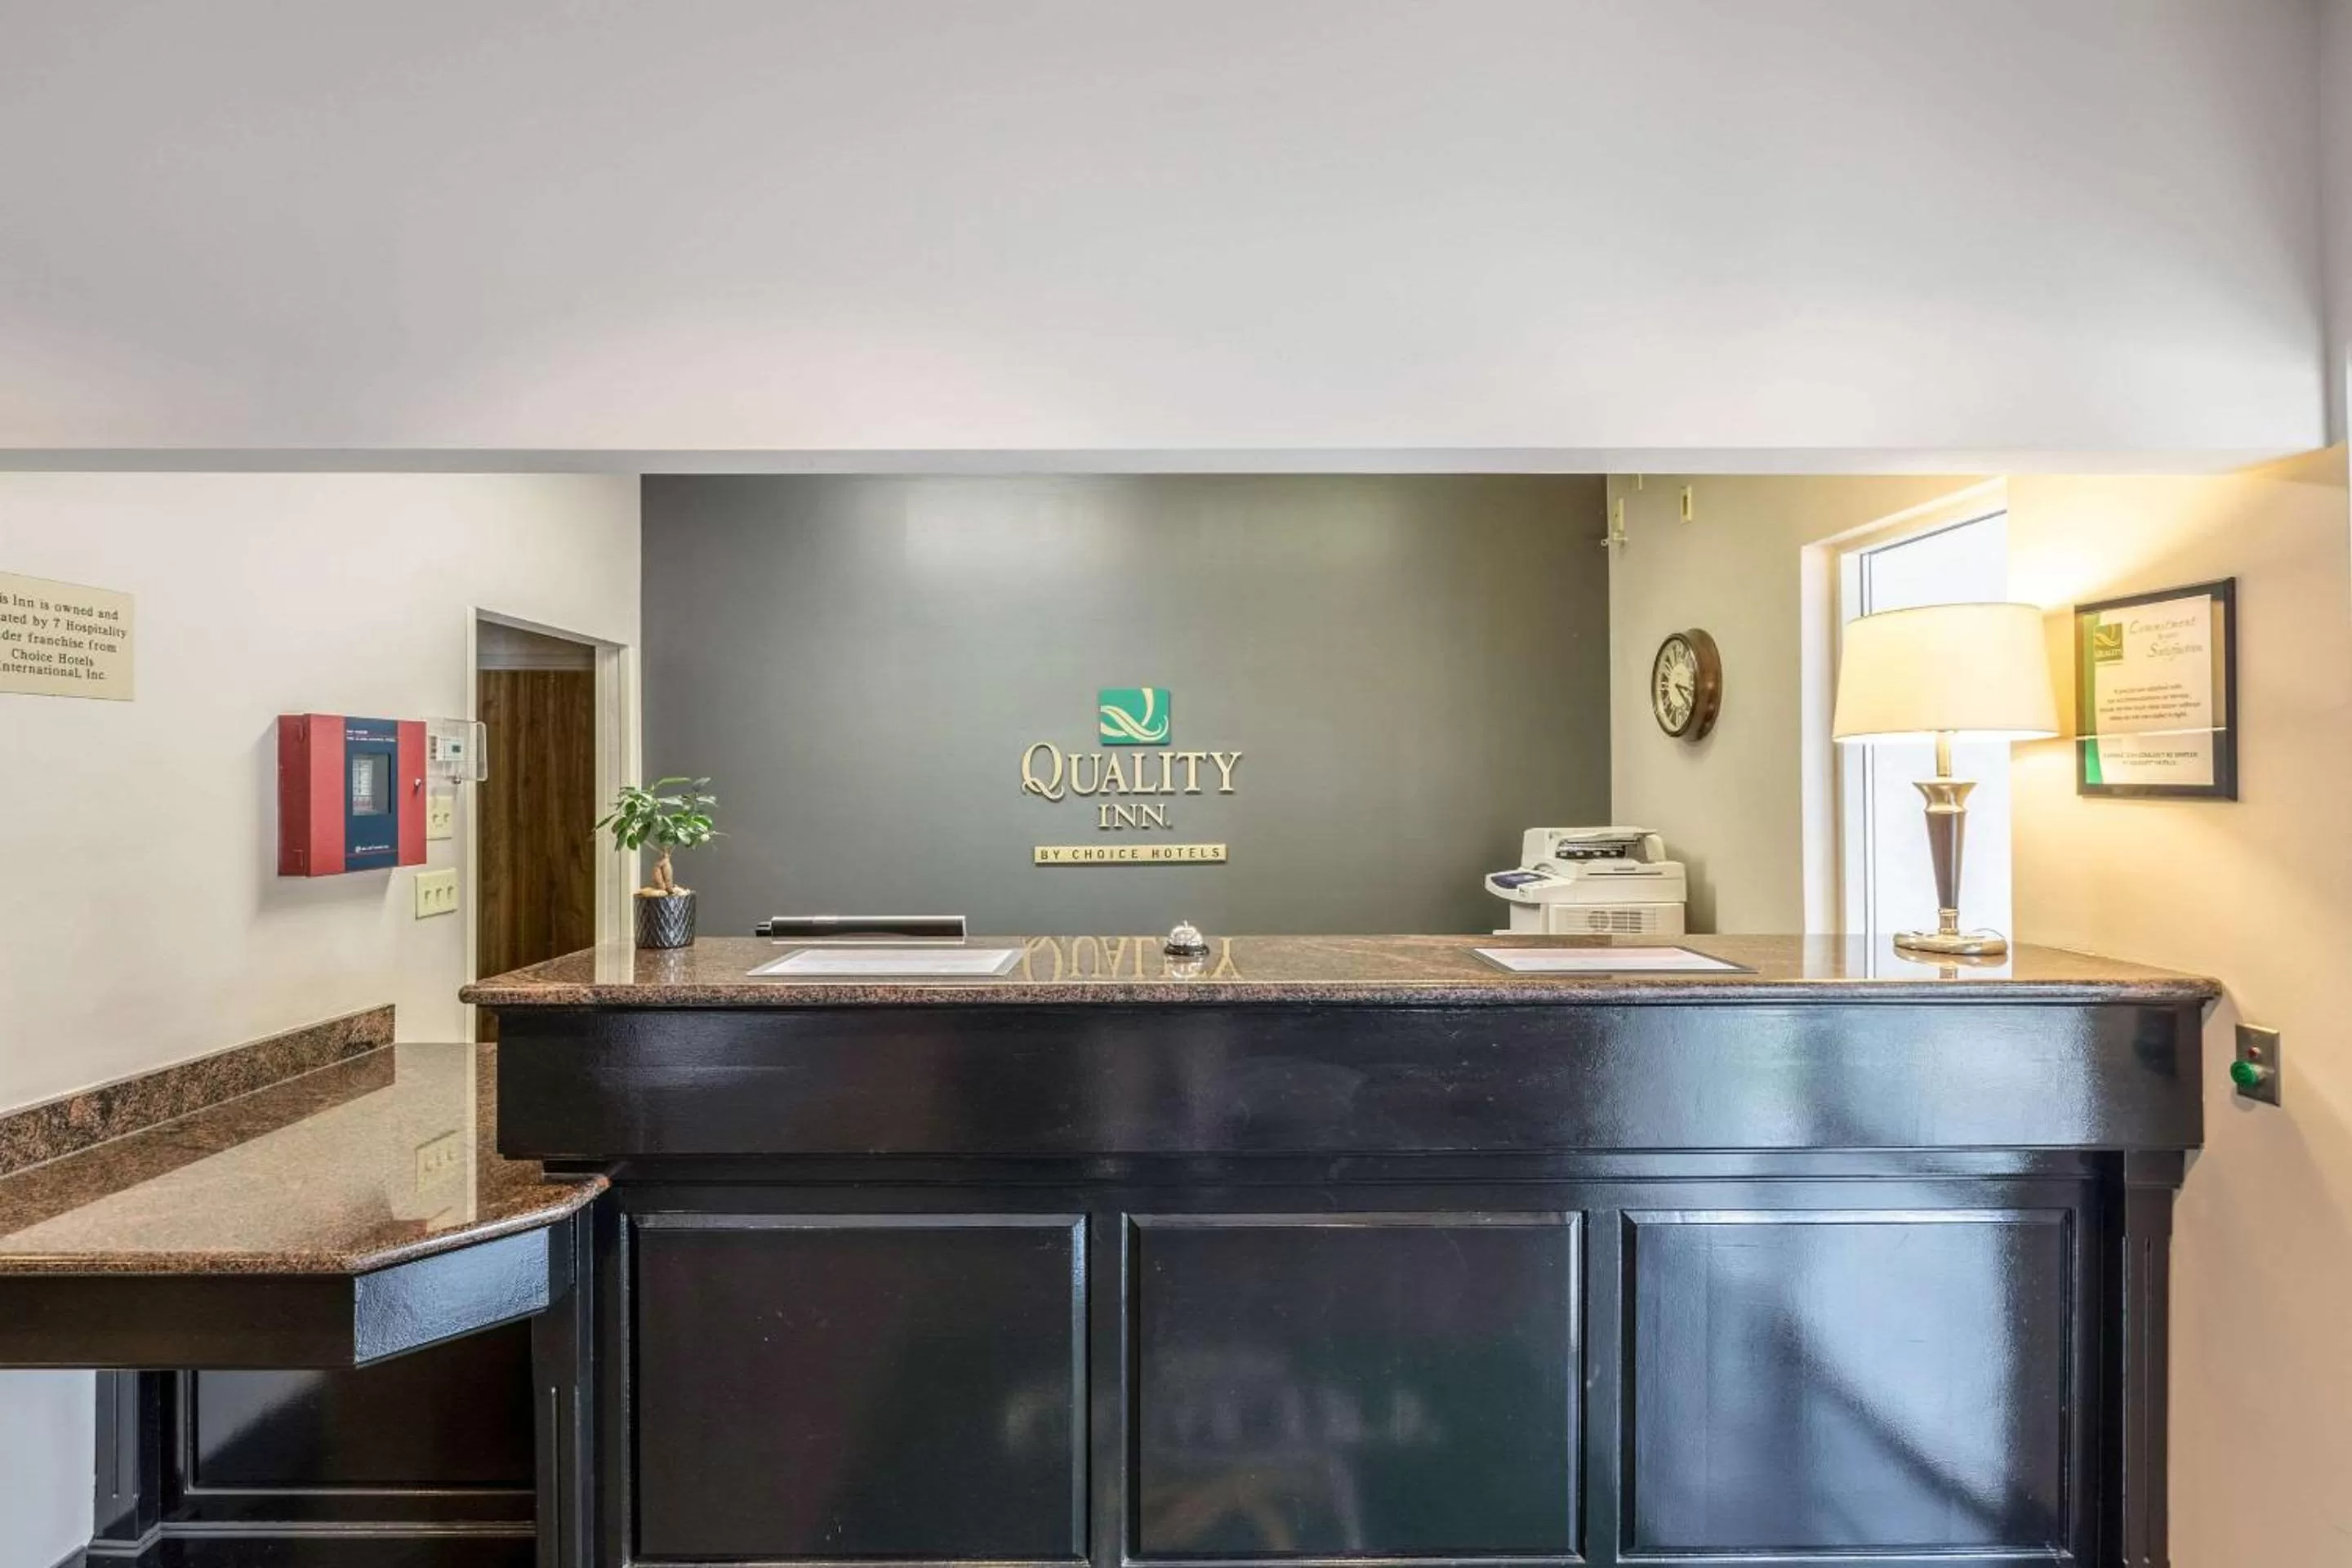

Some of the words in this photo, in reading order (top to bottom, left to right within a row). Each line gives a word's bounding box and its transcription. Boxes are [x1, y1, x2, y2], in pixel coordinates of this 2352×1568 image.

[13, 594, 33, 608] Inn
[40, 601, 50, 611] is
[54, 604, 93, 617] owned
[98, 610, 118, 621] and
[33, 615, 49, 630] by
[52, 617, 60, 628] 7
[66, 619, 127, 639] Hospitality
[28, 632, 84, 648] franchise
[88, 639, 117, 653] from
[11, 648, 53, 663] Choice
[58, 653, 95, 667] Hotels
[1022, 741, 1243, 801] QUALITY
[1040, 850, 1061, 860] BY
[1071, 849, 1139, 860] CHOICE
[1152, 848, 1220, 859] HOTELS
